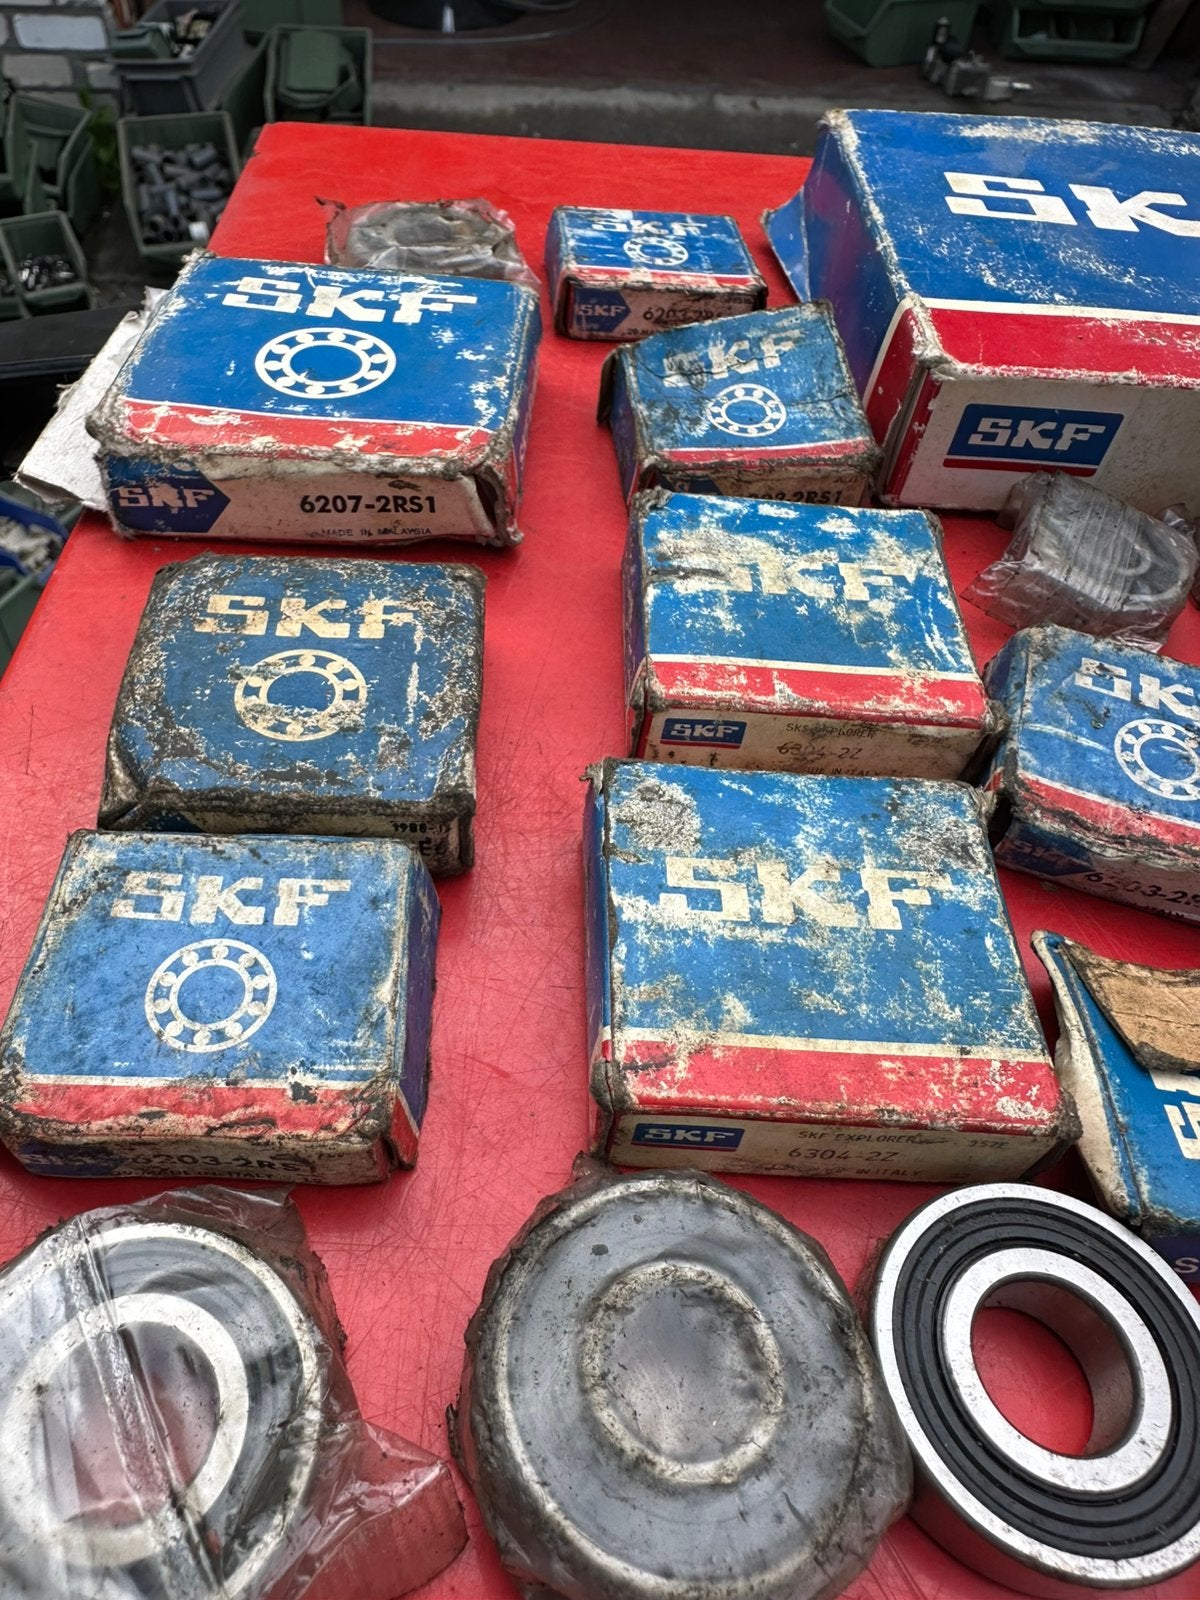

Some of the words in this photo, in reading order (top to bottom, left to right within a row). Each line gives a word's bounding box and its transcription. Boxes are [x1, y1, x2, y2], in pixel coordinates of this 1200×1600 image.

[222, 276, 477, 324] SKF
[578, 303, 626, 316] SKF
[968, 417, 1106, 450] SKF
[300, 495, 436, 513] 6207-2RS1
[194, 594, 422, 639] SKF
[670, 723, 739, 738] SKF
[110, 871, 351, 926] SKF
[659, 856, 953, 930] SKF
[644, 1128, 735, 1143] SKF
[800, 1131, 831, 1139] SKF
[834, 1133, 916, 1144] EXPLORER
[788, 1148, 899, 1162] 6304-2Z
